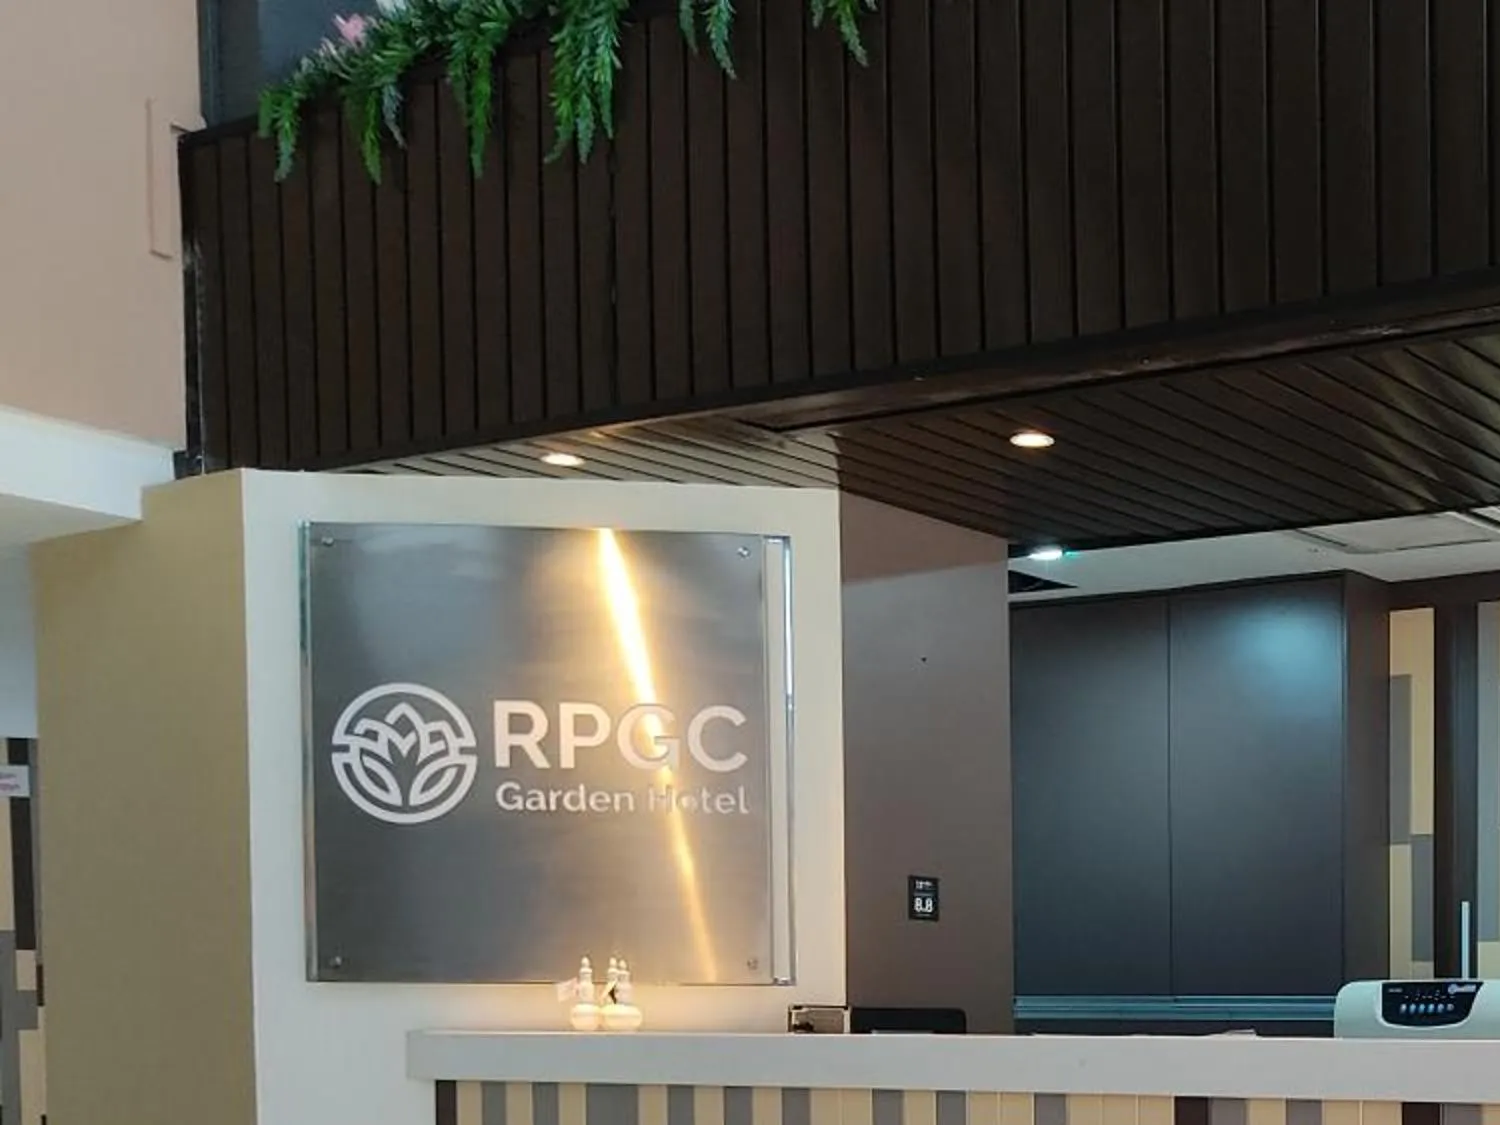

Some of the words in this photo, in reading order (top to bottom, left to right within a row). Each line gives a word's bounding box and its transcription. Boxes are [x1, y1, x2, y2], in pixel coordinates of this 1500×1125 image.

[493, 700, 748, 773] RPGC
[494, 781, 635, 812] Garden
[649, 784, 749, 814] Hotel
